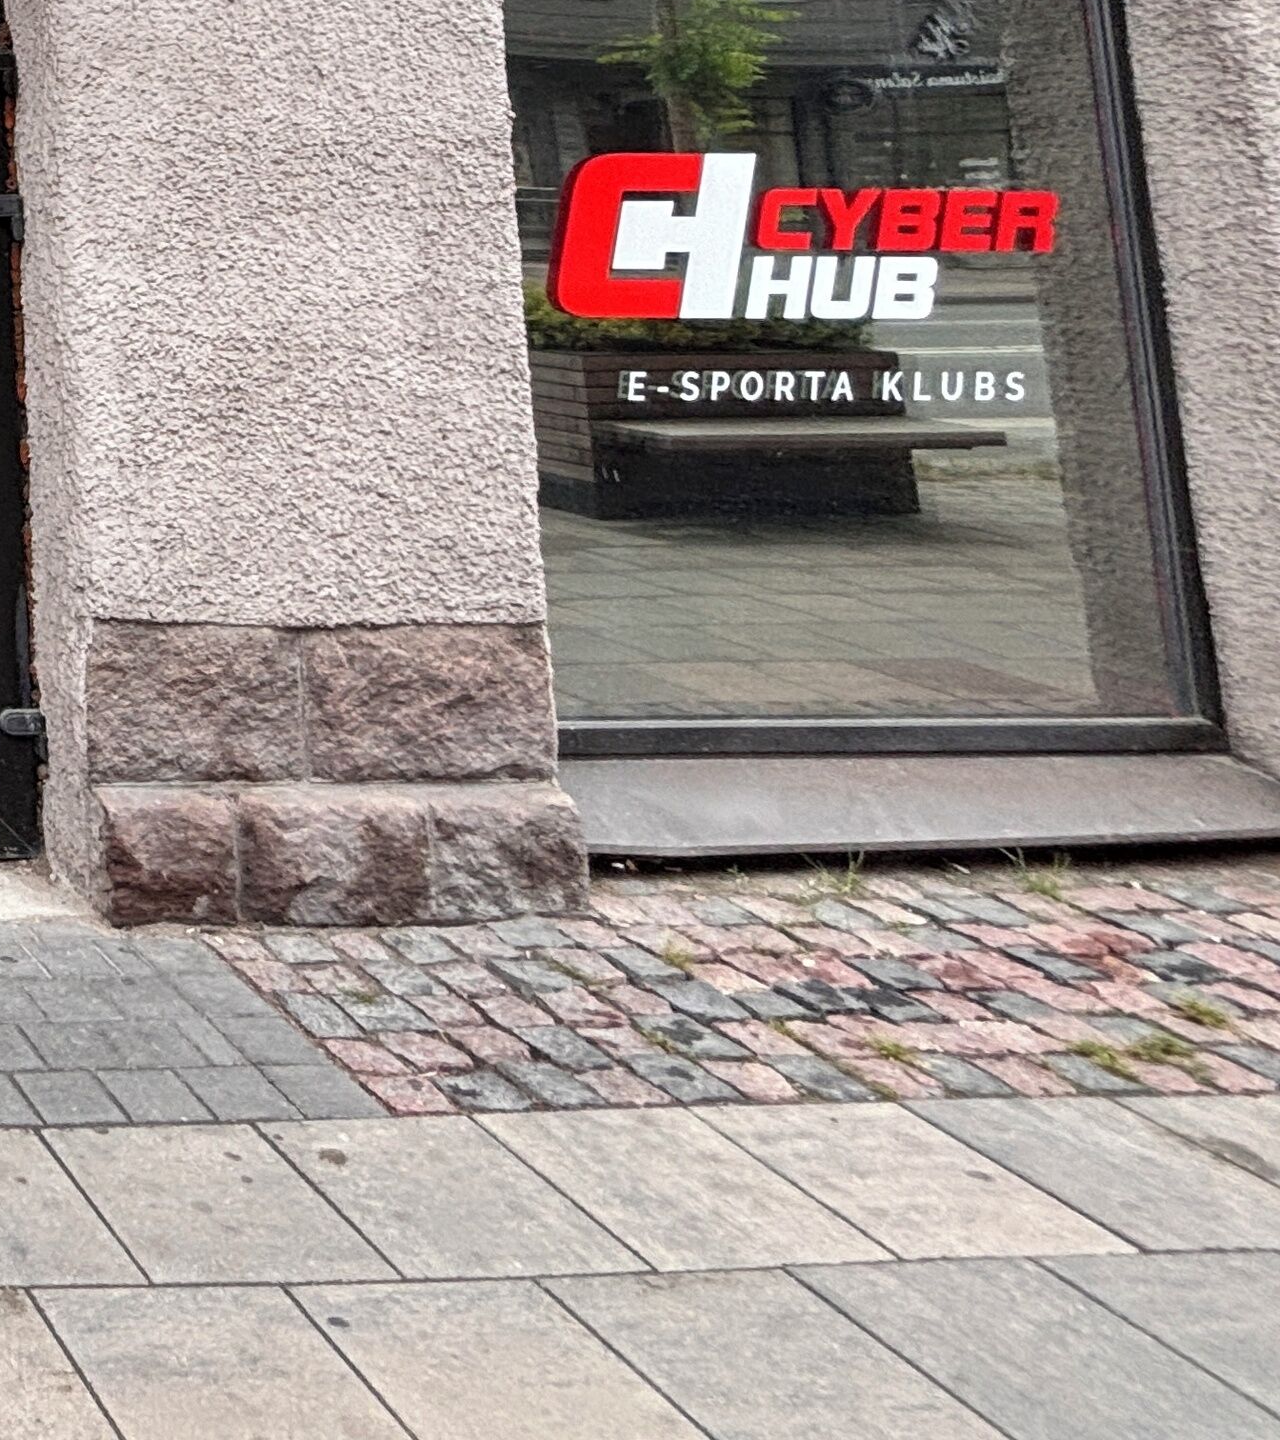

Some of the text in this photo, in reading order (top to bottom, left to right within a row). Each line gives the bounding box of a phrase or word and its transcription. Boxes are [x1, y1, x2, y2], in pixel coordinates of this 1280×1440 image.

[756, 187, 1060, 253] CYBER
[745, 256, 939, 320] HUB
[627, 371, 1025, 402] E-SPORTA KLUBS
